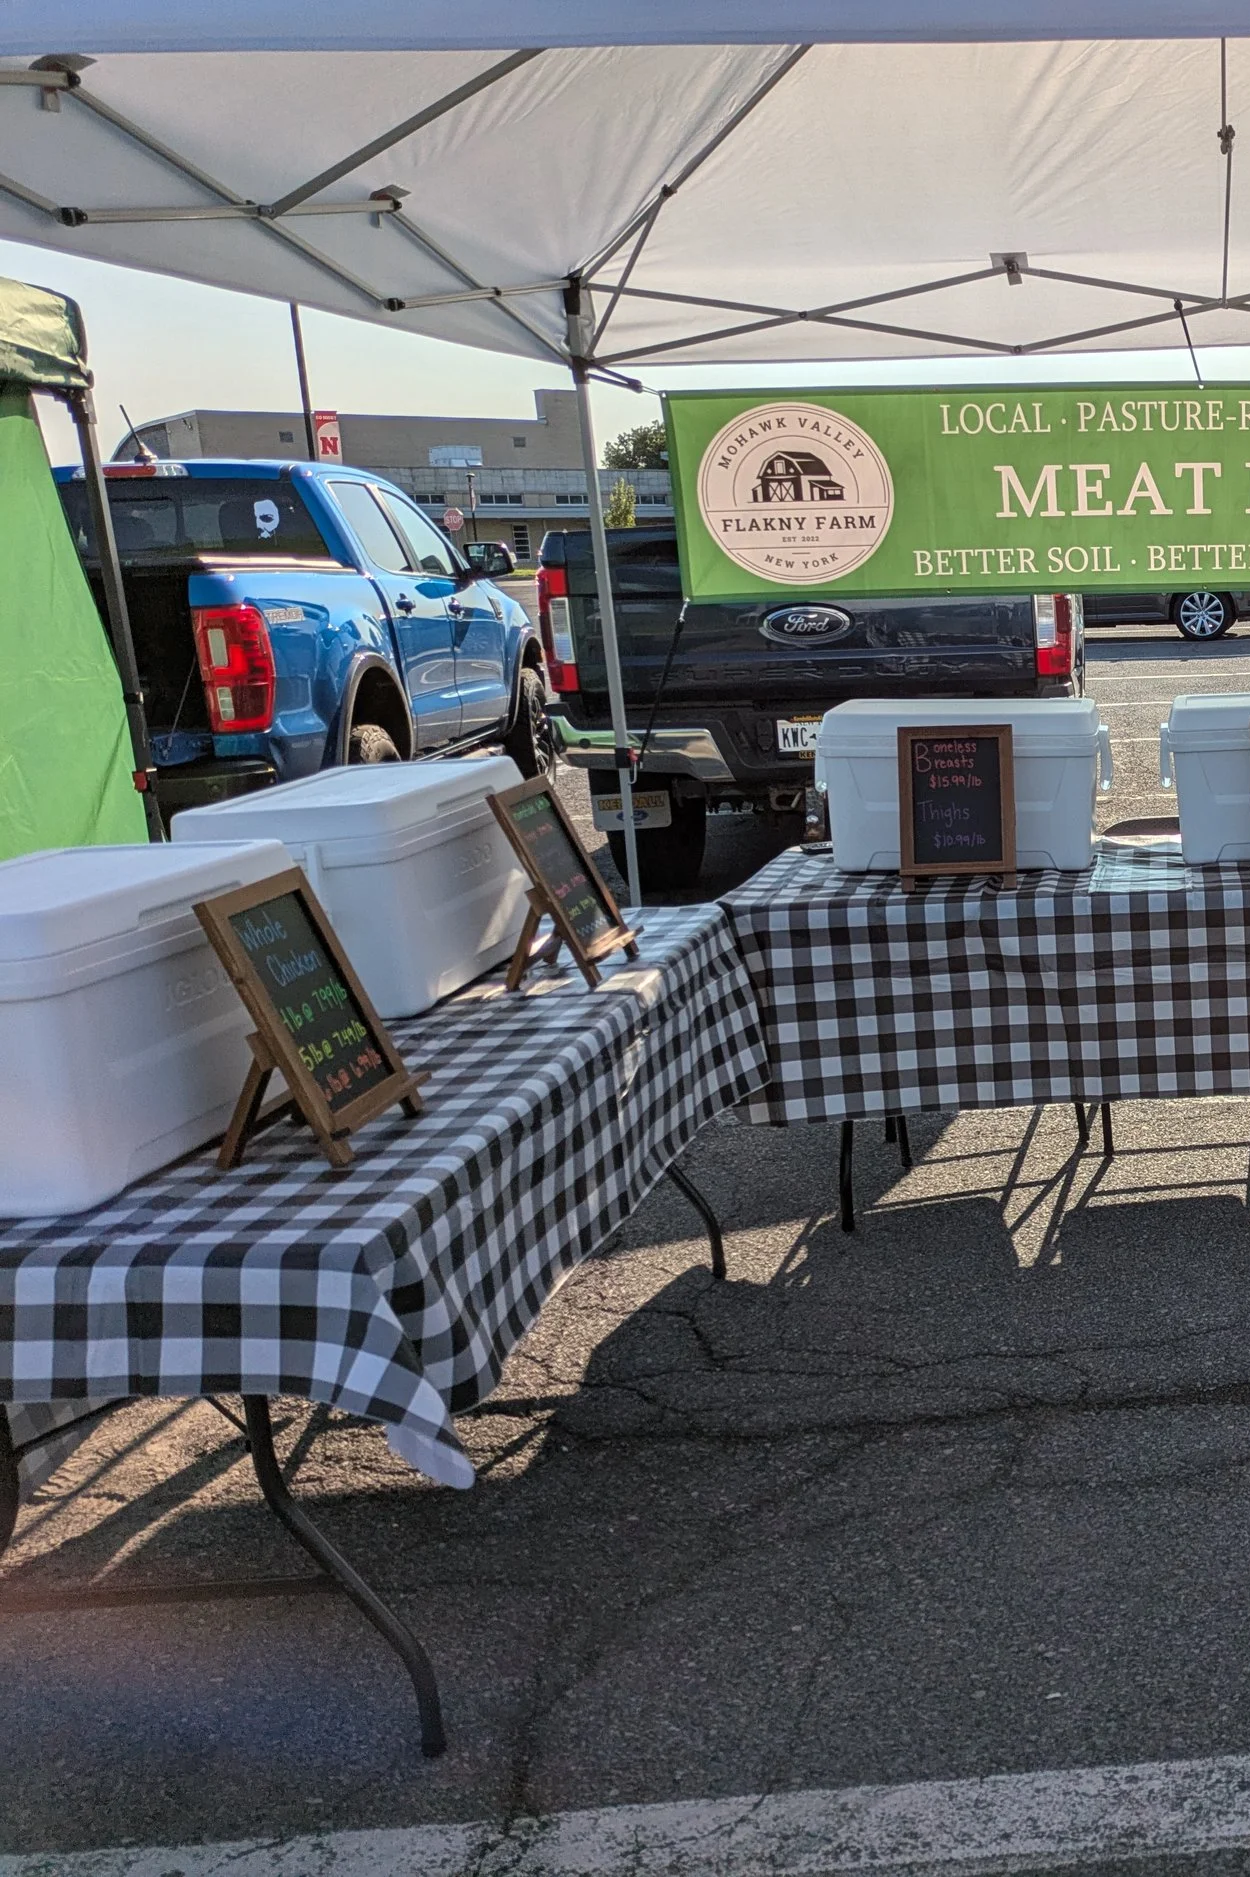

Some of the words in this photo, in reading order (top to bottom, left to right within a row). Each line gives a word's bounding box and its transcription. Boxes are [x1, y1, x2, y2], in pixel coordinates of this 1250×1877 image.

[940, 402, 1051, 435] LOCAL
[320, 436, 339, 455] N
[718, 417, 788, 470] MOHAWK
[798, 417, 866, 461] VALLEY
[993, 461, 1222, 519] MEAT
[722, 516, 807, 533] FLAKNY
[815, 515, 877, 531] FARM
[801, 535, 820, 543] 2022
[764, 554, 796, 570] NEW
[802, 552, 840, 570] YORK
[913, 548, 1040, 577] BETTER
[1047, 546, 1121, 574] SOIL
[783, 613, 830, 634] Ford
[916, 799, 971, 828] Thighs
[239, 911, 288, 950] Whole
[265, 950, 323, 987] Chicken
